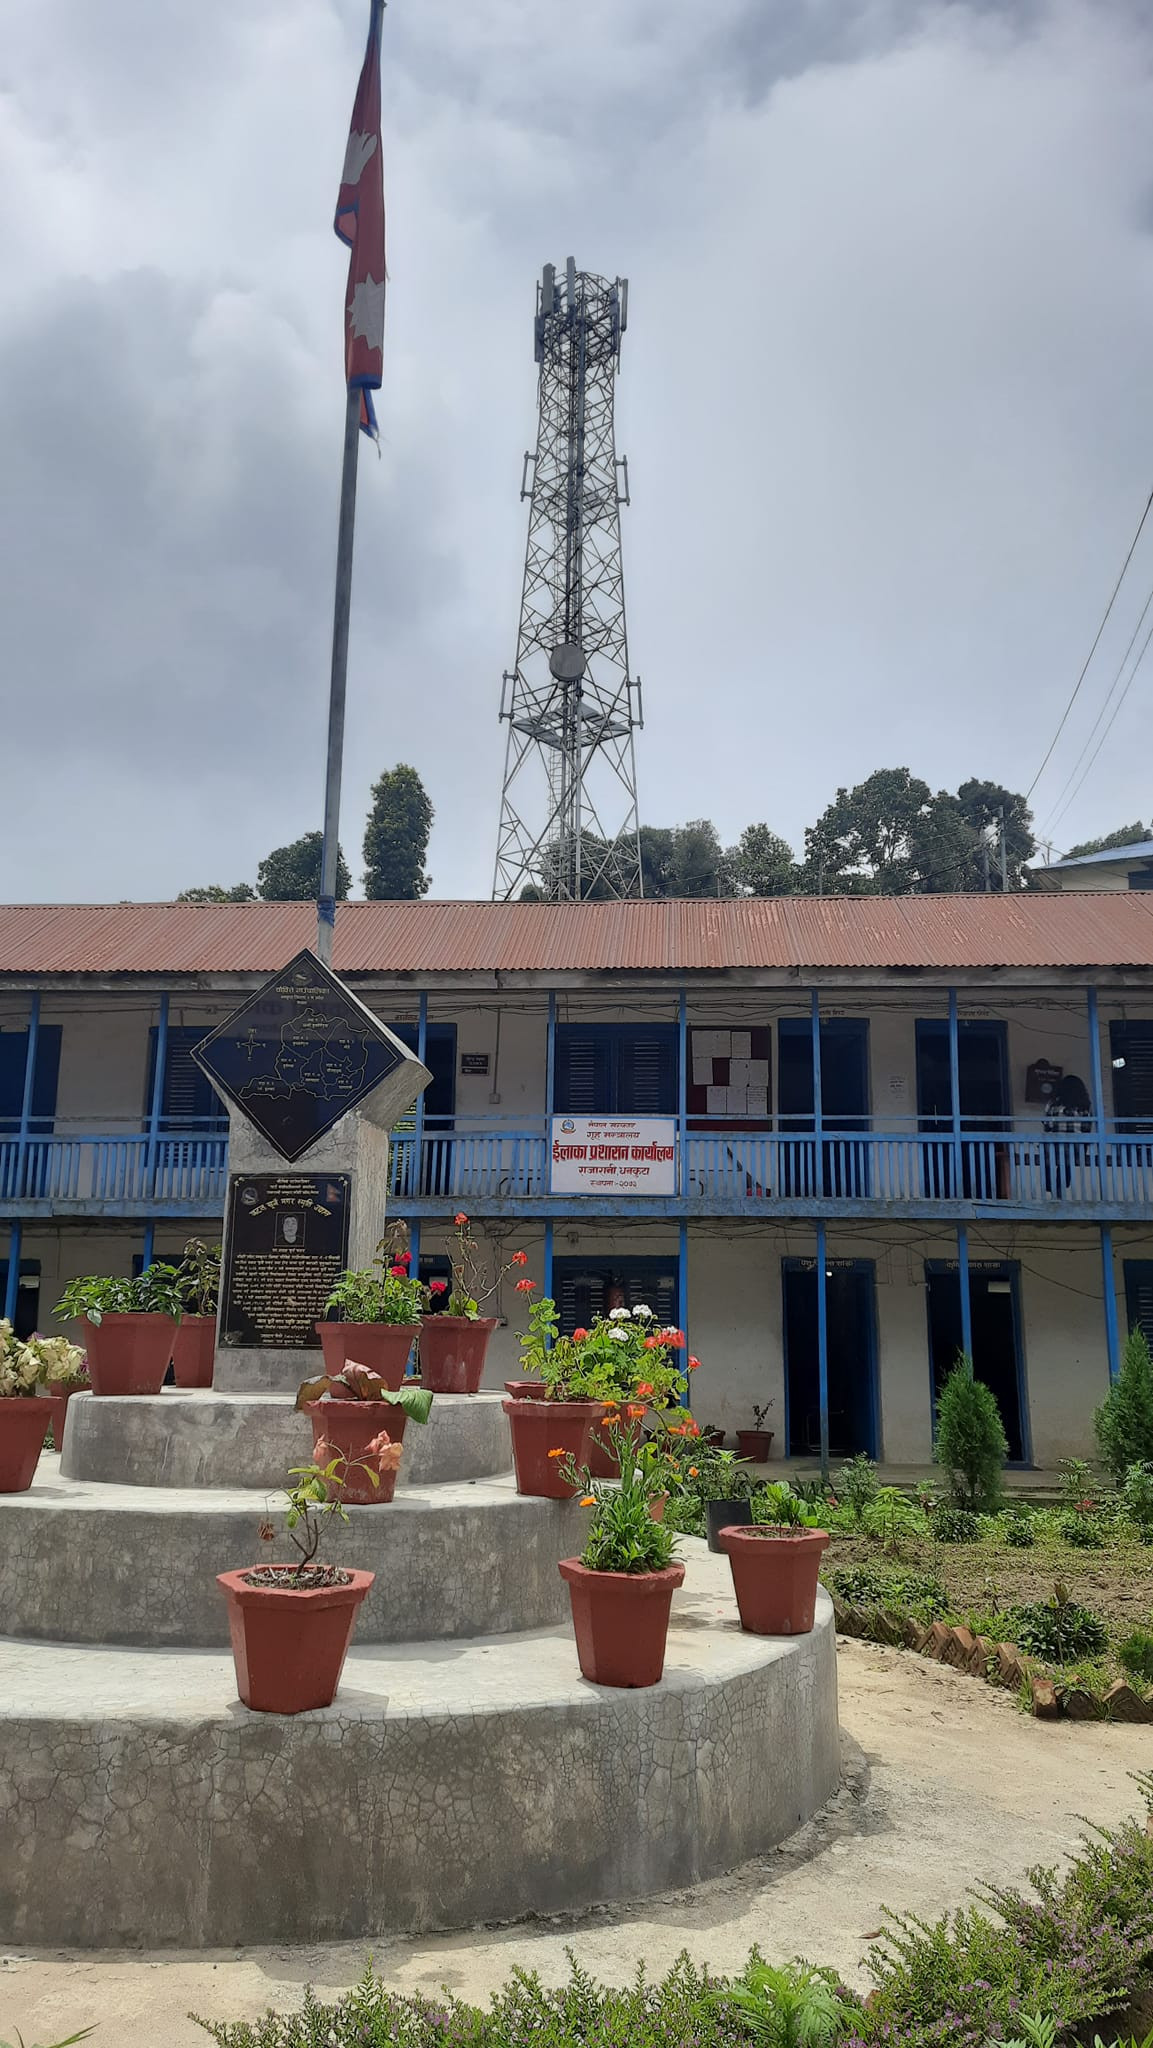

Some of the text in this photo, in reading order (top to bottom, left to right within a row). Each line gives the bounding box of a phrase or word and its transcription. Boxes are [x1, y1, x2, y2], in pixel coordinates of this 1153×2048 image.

[588, 1120, 607, 1128] नेपाल
[586, 1131, 641, 1140] गृह मन्त्रालय
[552, 1140, 675, 1162] ईलाका प्रशासन कार्यालय
